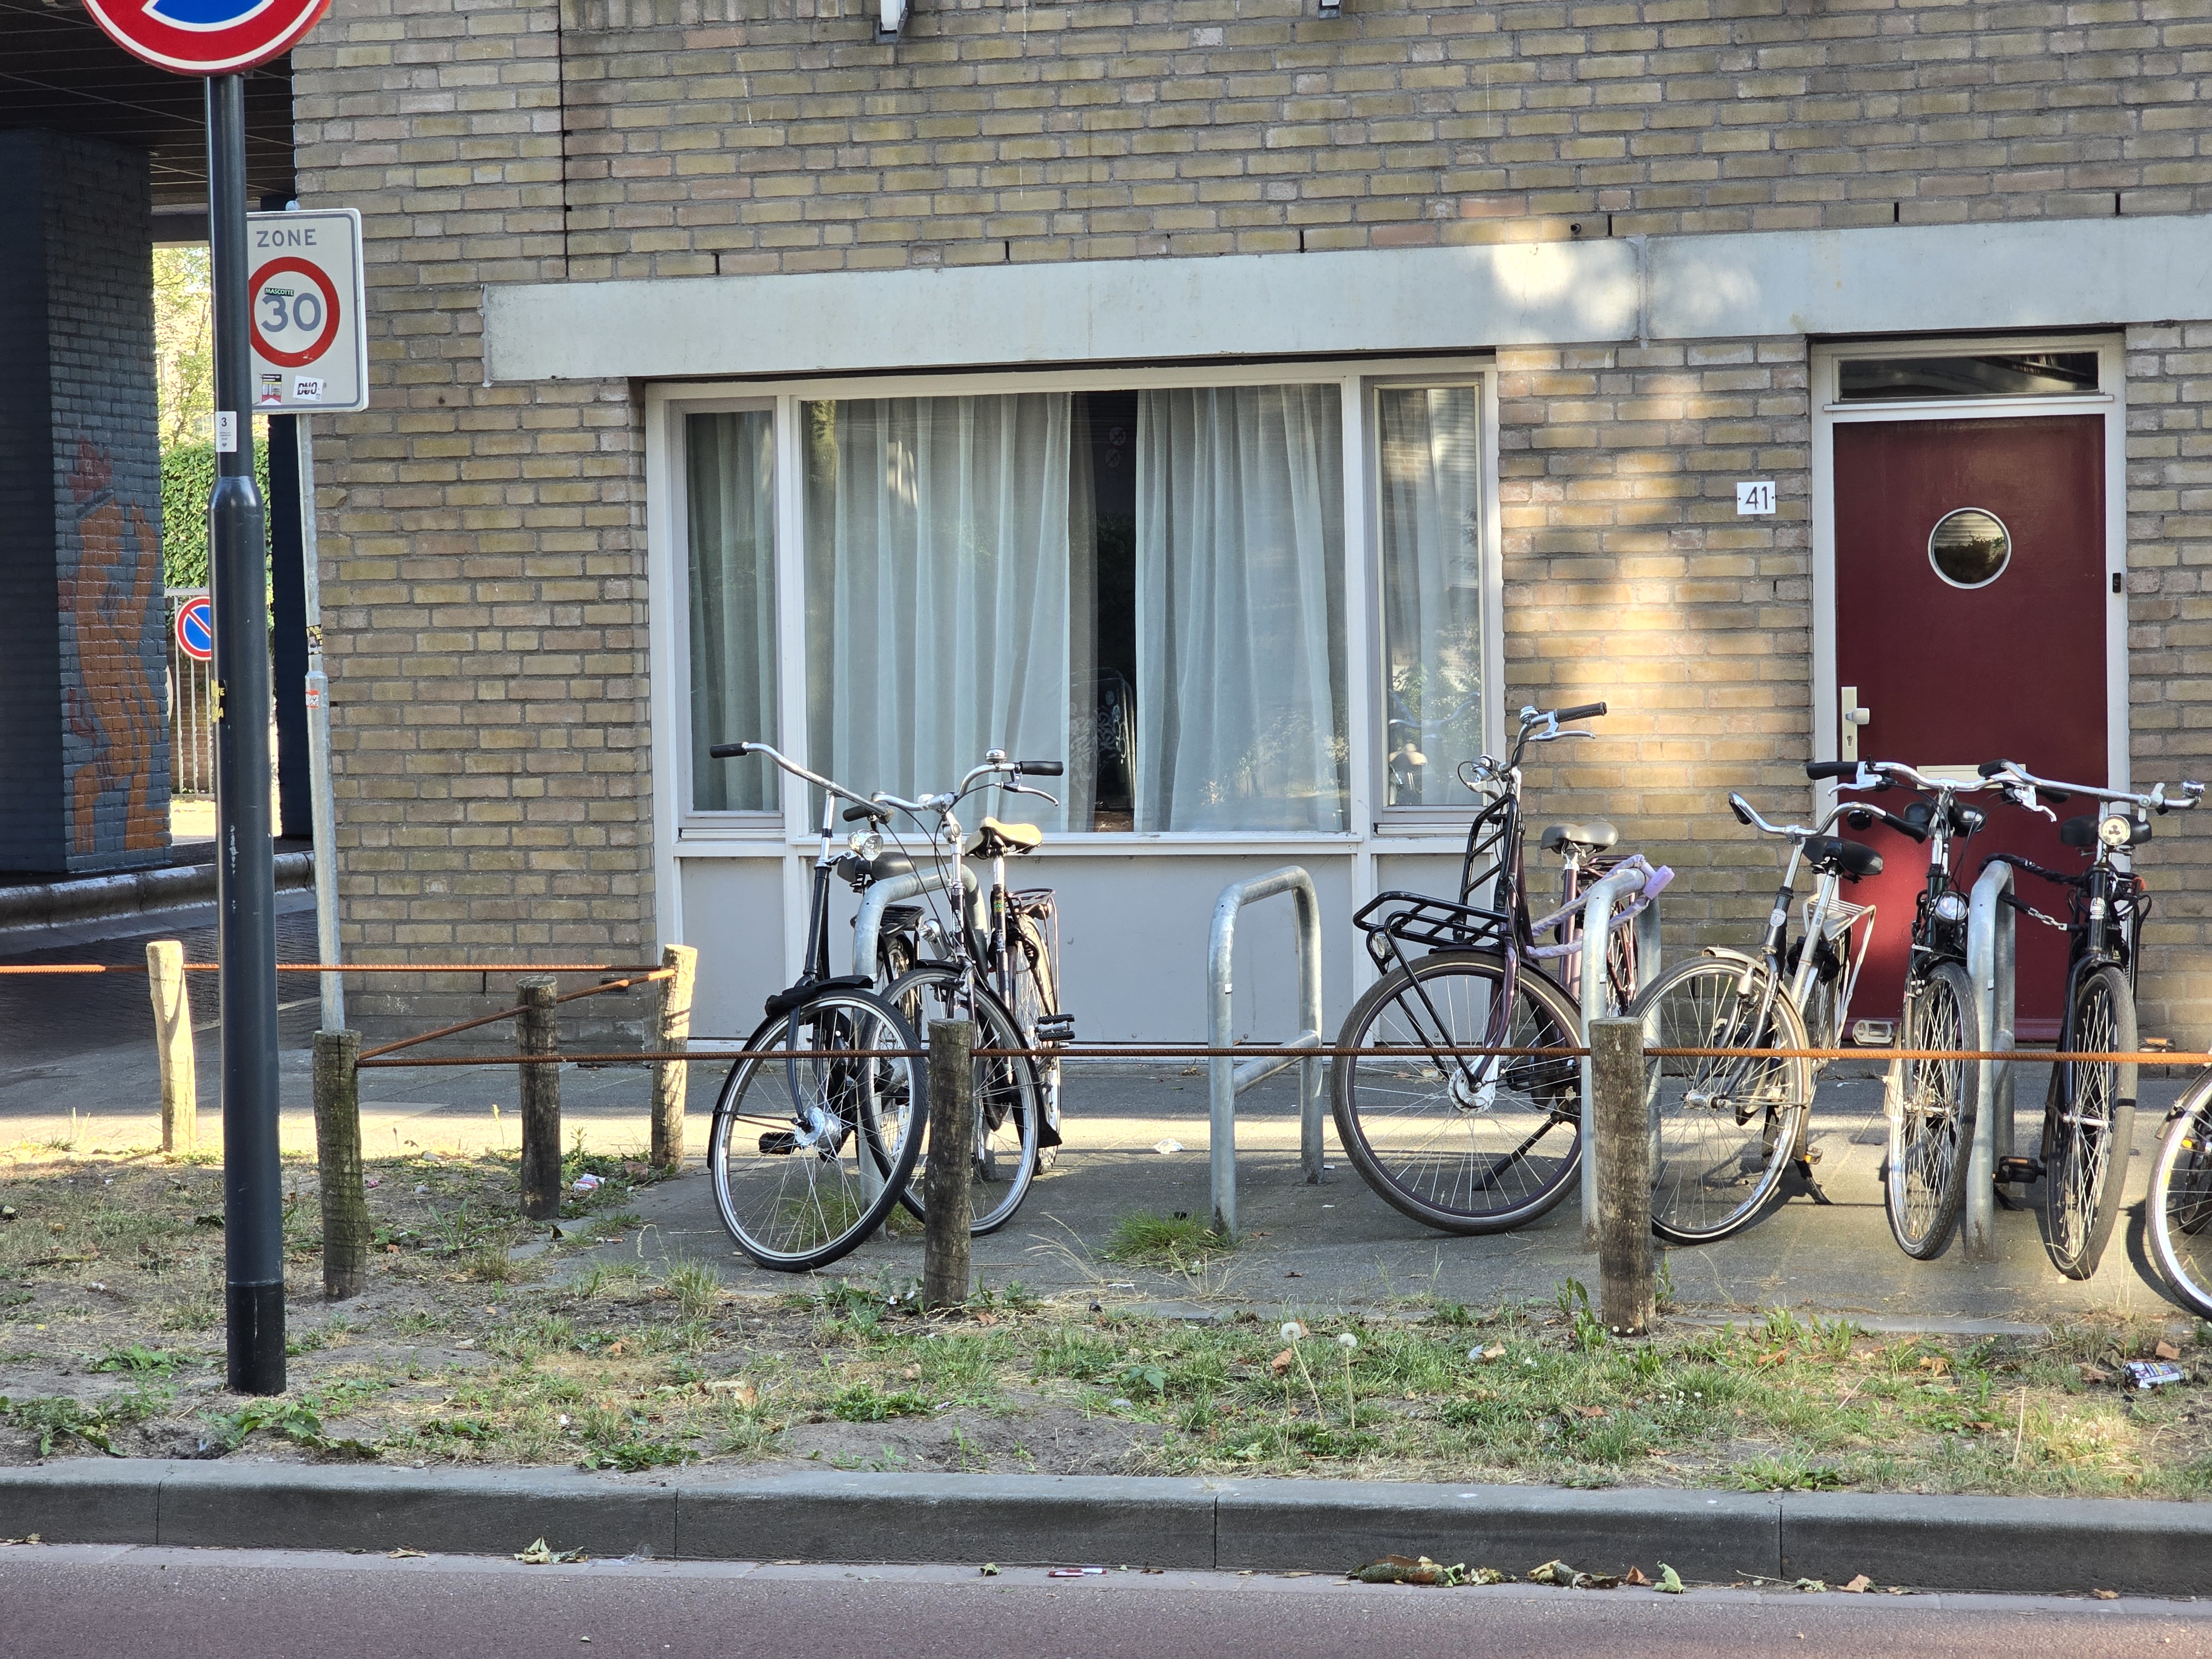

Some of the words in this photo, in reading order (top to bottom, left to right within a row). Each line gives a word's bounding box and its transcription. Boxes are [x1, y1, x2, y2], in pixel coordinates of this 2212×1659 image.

[256, 228, 317, 248] ZONE
[261, 293, 321, 332] 30
[221, 416, 227, 427] 3
[1745, 486, 1768, 510] 41
